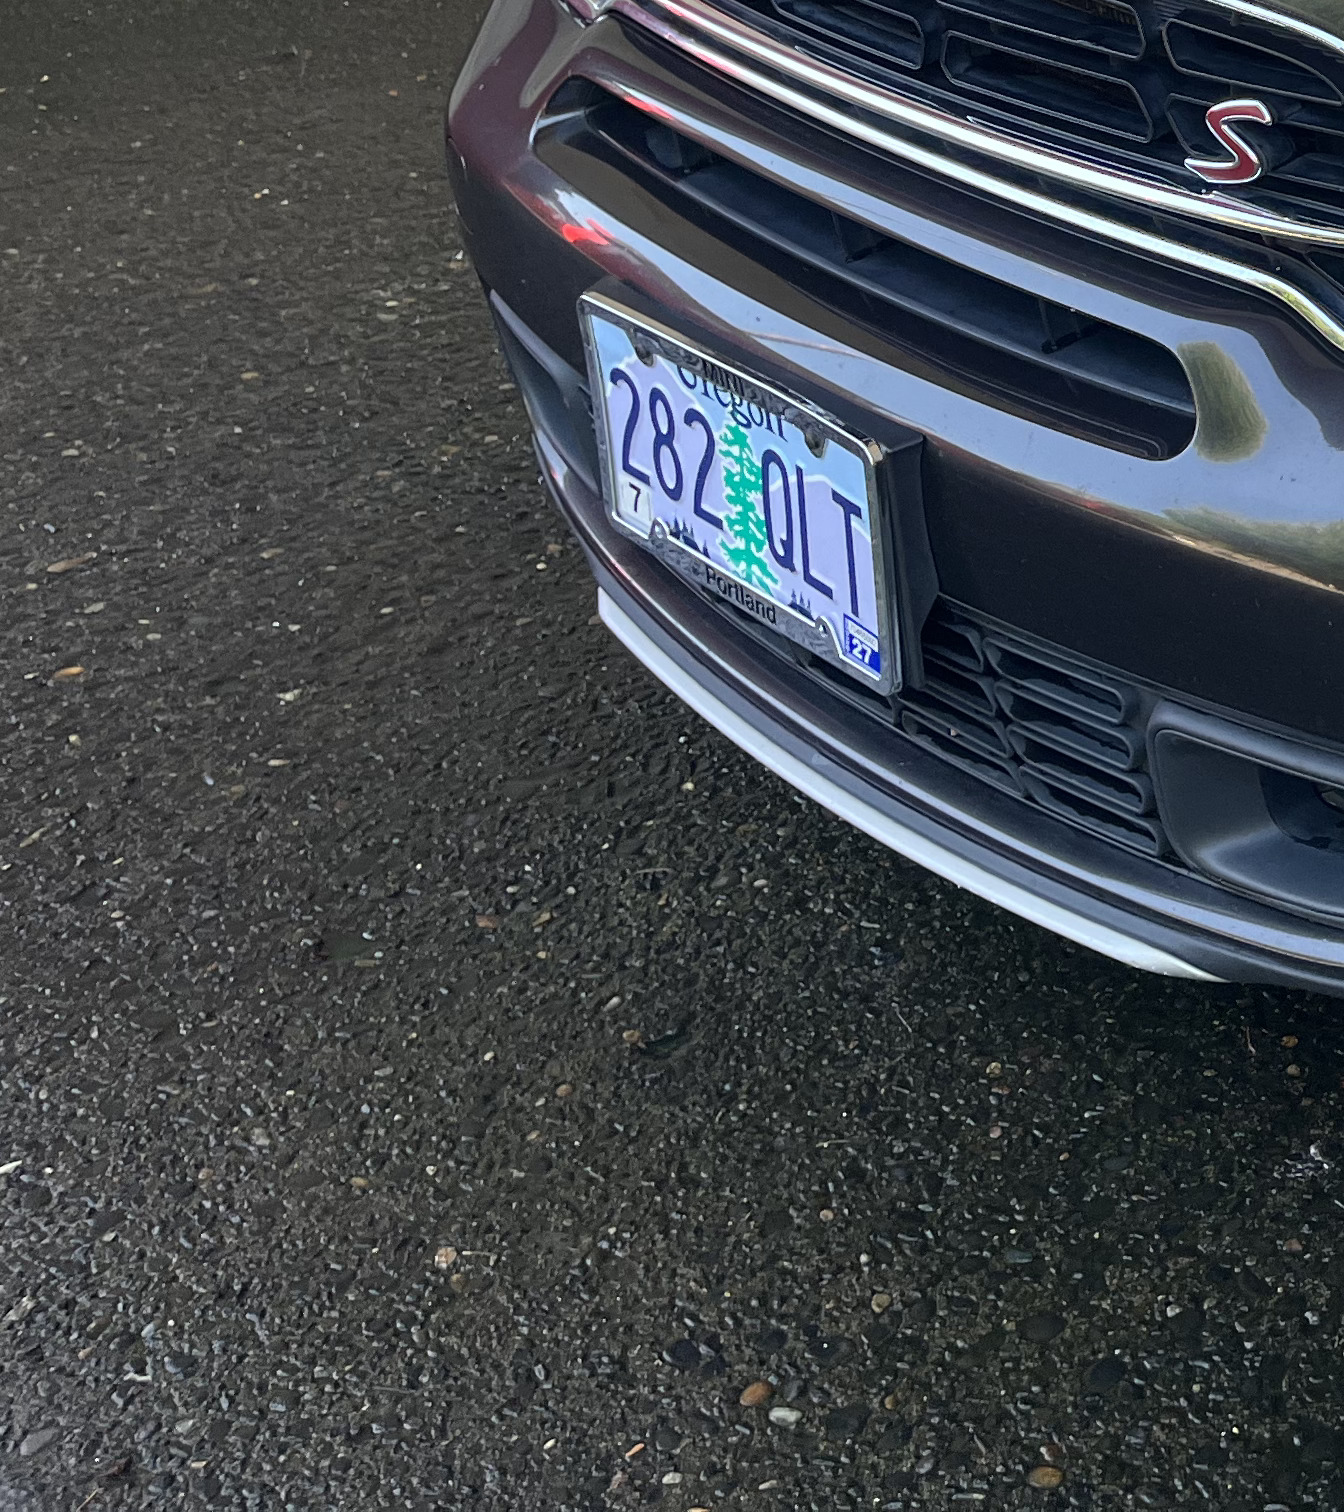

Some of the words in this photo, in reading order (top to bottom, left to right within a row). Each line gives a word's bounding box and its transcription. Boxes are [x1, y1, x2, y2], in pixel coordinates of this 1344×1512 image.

[1183, 98, 1274, 185] S
[609, 367, 724, 531] 282
[761, 448, 863, 619] QLT
[628, 481, 642, 513] 7
[704, 562, 777, 626] Portland
[850, 637, 873, 665] 27
